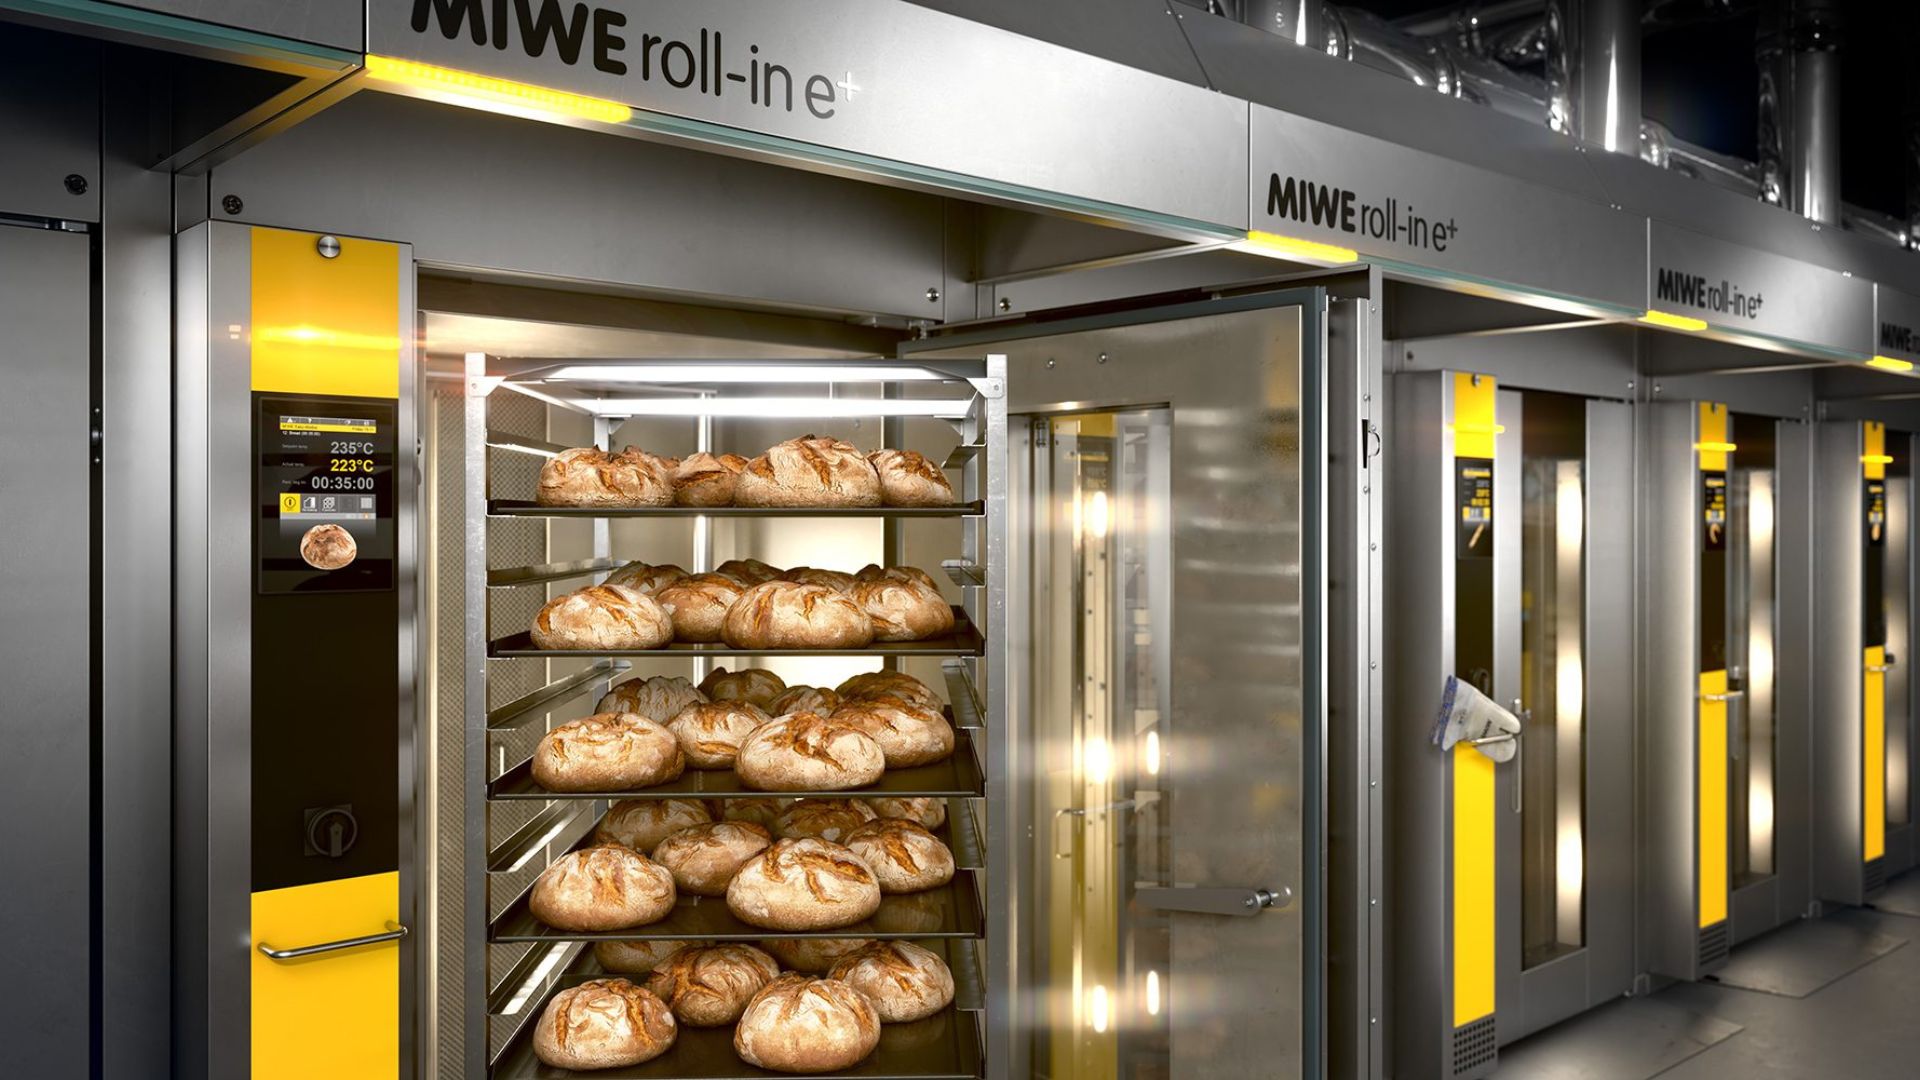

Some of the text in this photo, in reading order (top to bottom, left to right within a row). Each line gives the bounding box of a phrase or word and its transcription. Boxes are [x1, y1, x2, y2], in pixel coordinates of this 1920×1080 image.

[411, 0, 628, 77] MIWE
[642, 27, 794, 113] roll-in
[1267, 172, 1356, 233] MIWE
[1361, 197, 1428, 249] roll-in
[1657, 267, 1706, 309] MIWE
[1707, 280, 1746, 317] roll-in
[330, 441, 374, 455] 235°C
[330, 458, 374, 473] 223°C
[311, 475, 375, 490] 00:35:00
